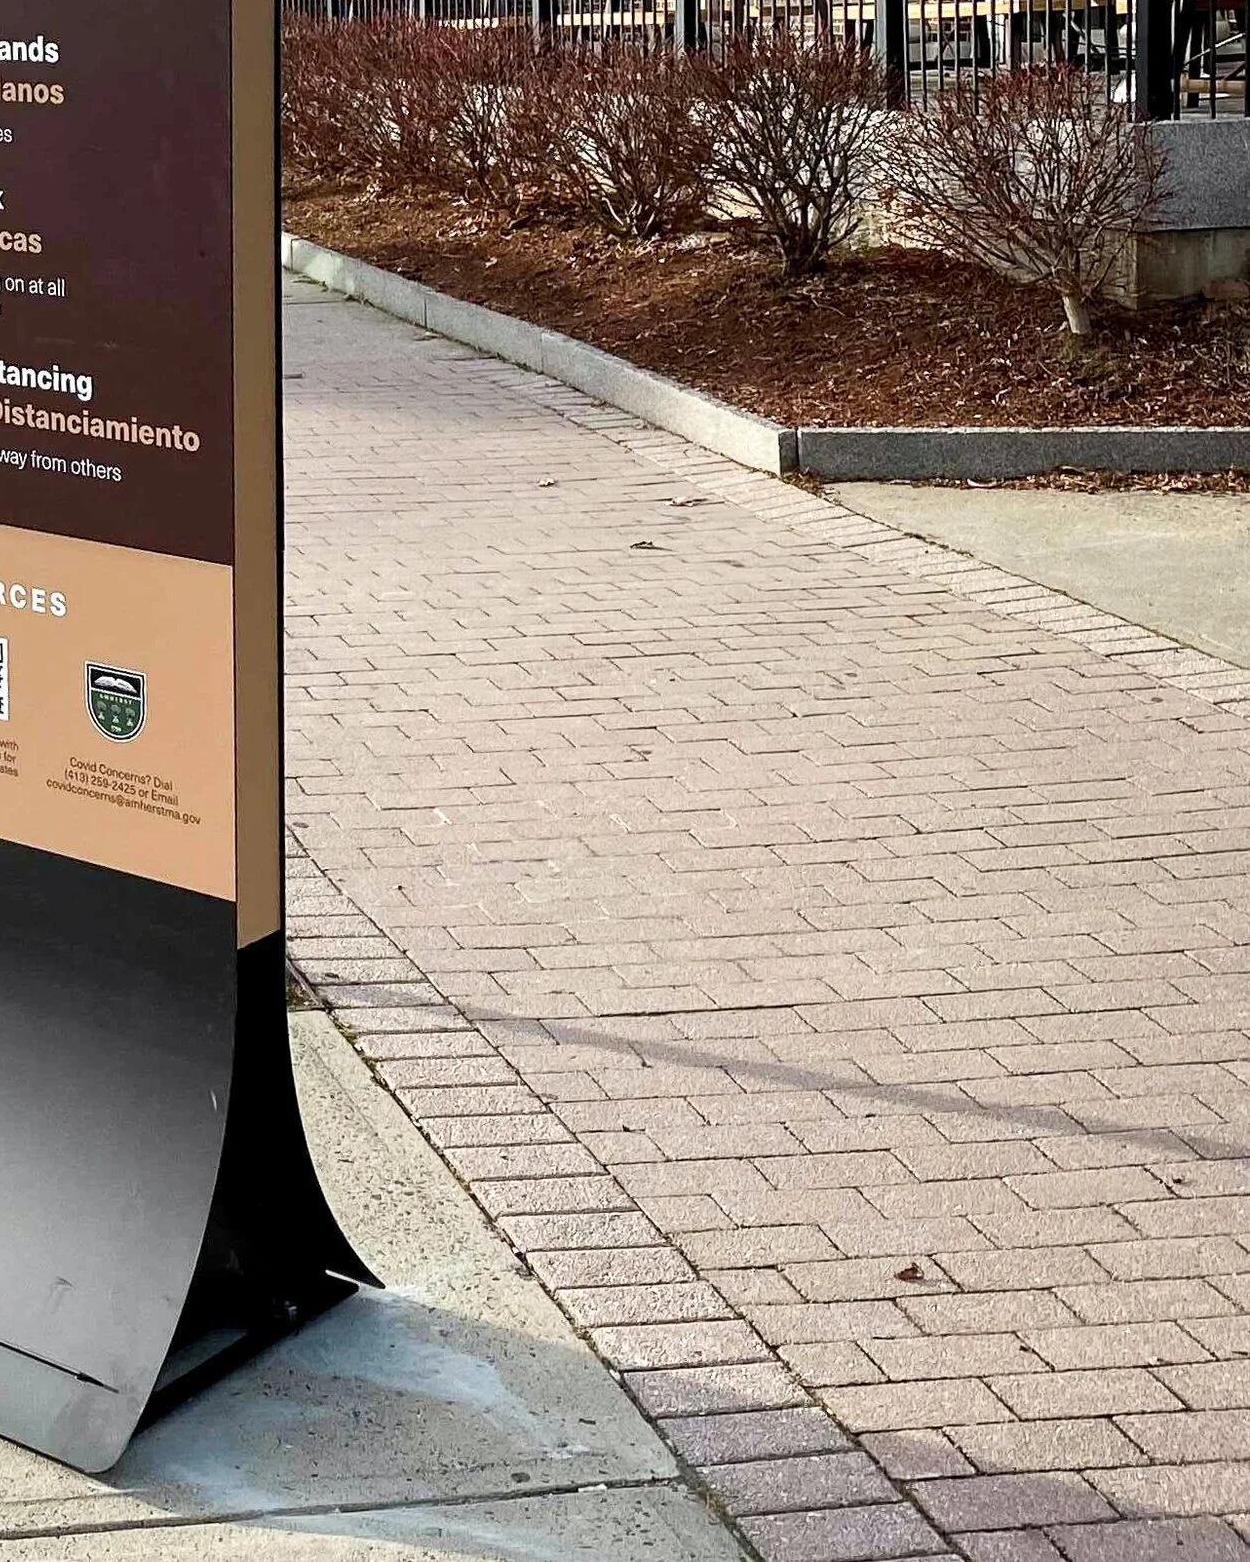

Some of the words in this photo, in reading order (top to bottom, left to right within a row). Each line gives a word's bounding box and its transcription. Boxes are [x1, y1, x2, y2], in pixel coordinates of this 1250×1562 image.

[5, 276, 25, 292] on
[28, 278, 45, 295] at
[47, 278, 66, 298] all
[30, 449, 67, 473] from
[70, 458, 123, 482] others
[0, 739, 19, 751] with
[3, 751, 17, 765] for
[64, 768, 89, 785] (413)
[91, 775, 136, 795] 259-2425
[138, 788, 149, 798] or
[151, 789, 179, 807] Email
[69, 756, 97, 773] Covid
[99, 763, 151, 785] Concerns?
[153, 776, 173, 791] Dial
[46, 778, 201, 826] covidconcerns@amherstma.gov
